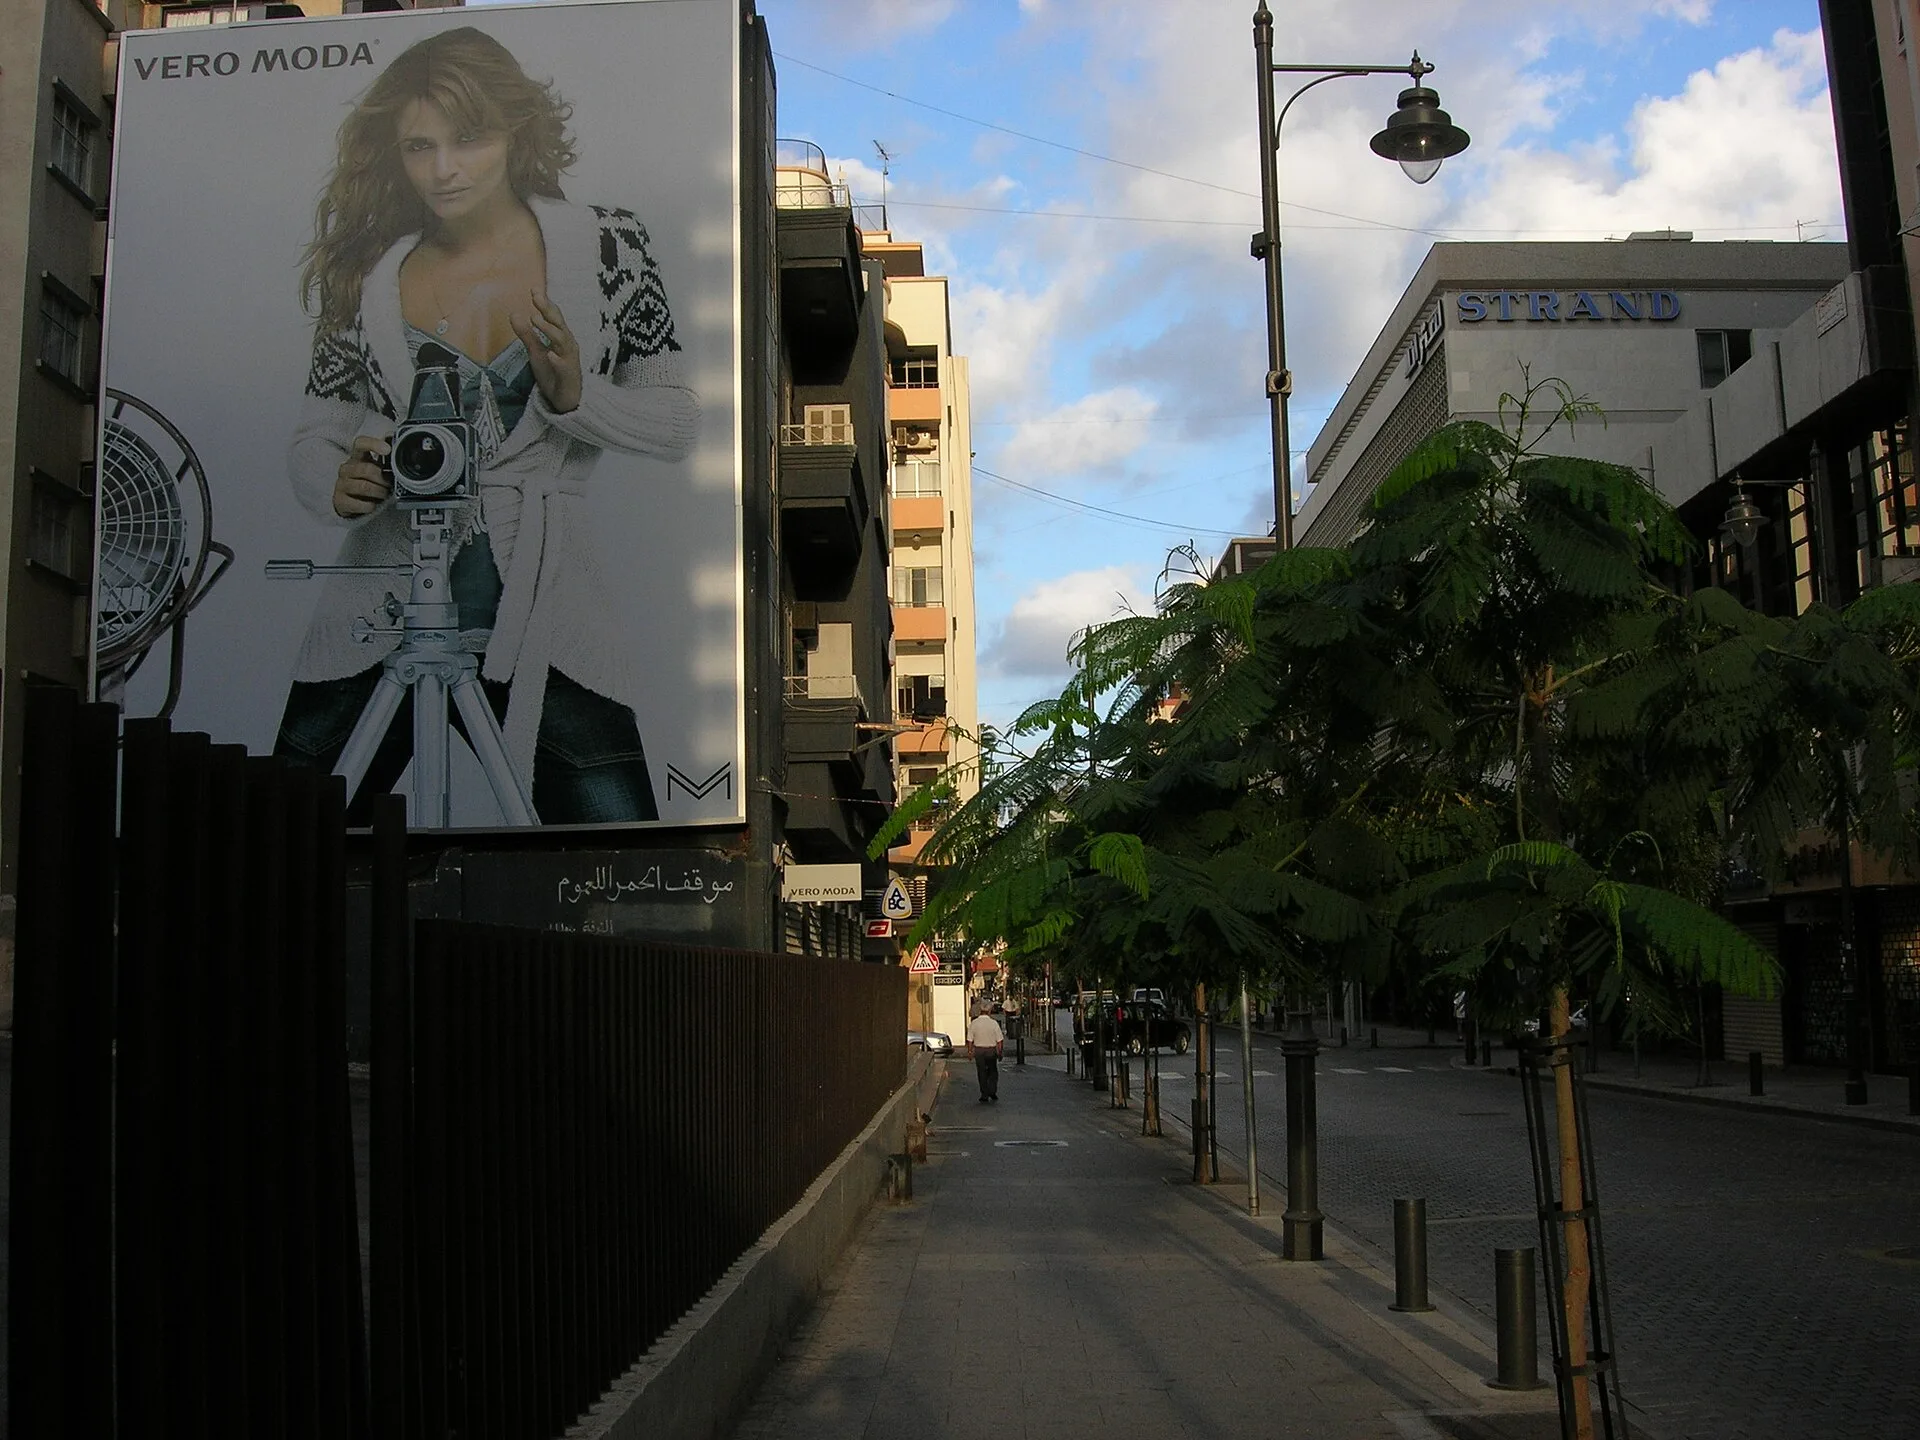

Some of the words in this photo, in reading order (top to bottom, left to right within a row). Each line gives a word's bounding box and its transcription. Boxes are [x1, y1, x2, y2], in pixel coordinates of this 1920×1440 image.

[133, 51, 240, 81] VERO
[251, 42, 375, 74] MODA
[1456, 289, 1682, 322] STRAND
[664, 868, 734, 904] موقف
[791, 887, 820, 896] VERO
[822, 887, 856, 896] MODA
[888, 887, 906, 910] ABC
